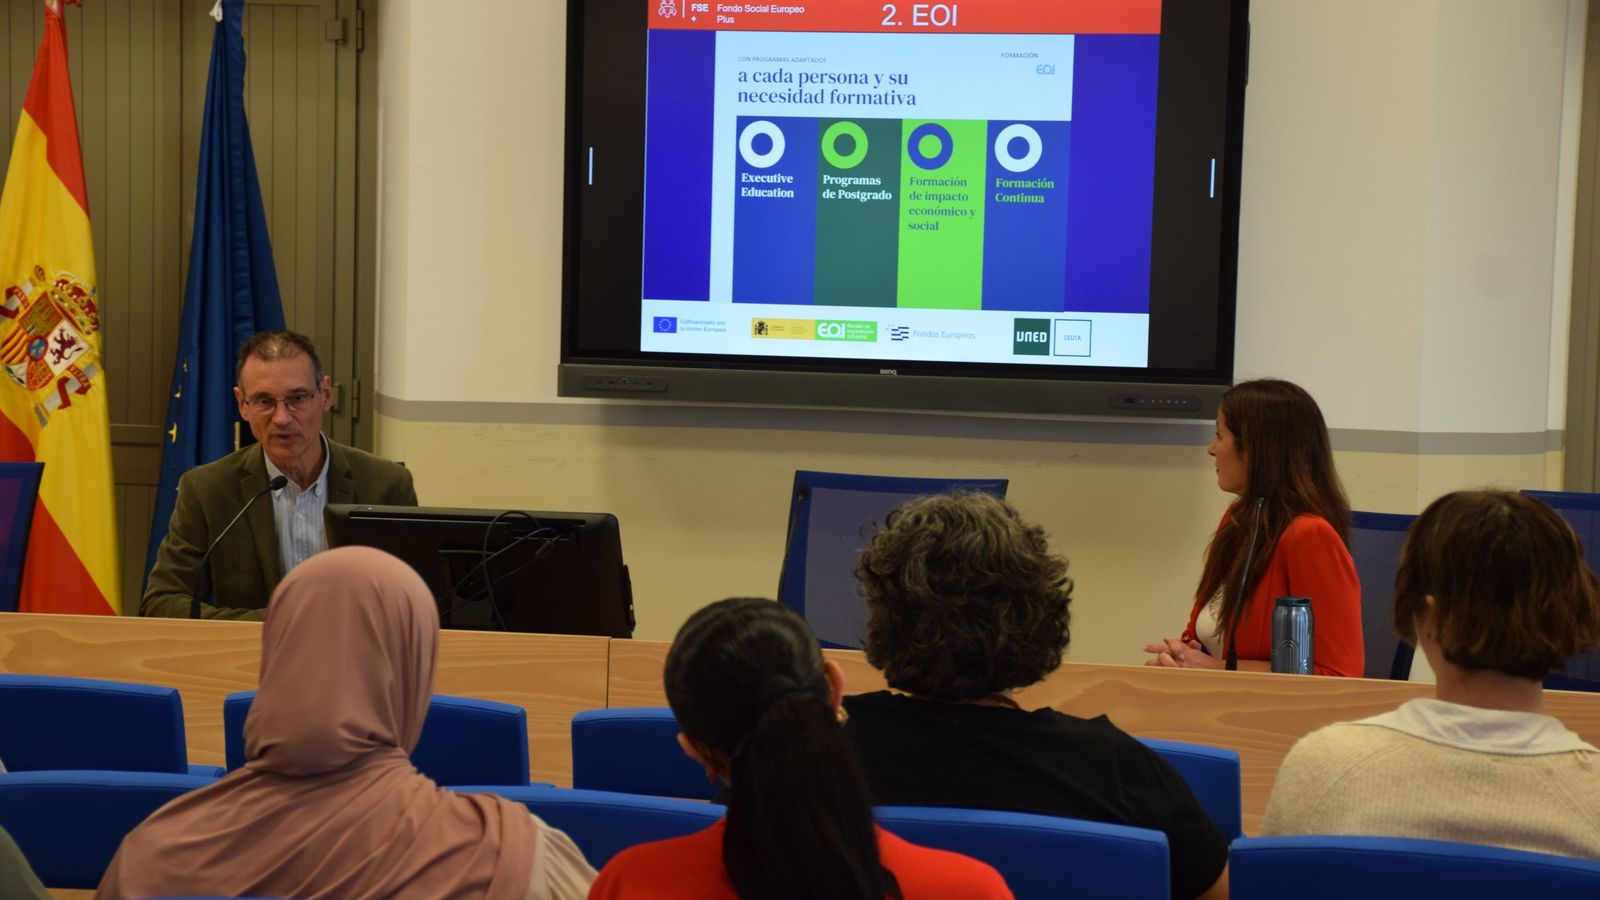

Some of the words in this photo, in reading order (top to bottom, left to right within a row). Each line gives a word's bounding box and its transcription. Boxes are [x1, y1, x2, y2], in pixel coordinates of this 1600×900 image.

[691, 3, 709, 12] FSE
[717, 3, 743, 13] Fondo
[744, 4, 769, 13] Social
[770, 4, 805, 15] Europeo
[717, 15, 735, 24] Plus
[882, 4, 903, 27] 2.
[912, 4, 958, 27] EOI
[738, 71, 748, 83] a
[752, 68, 794, 84] cada
[798, 72, 869, 88] persona
[873, 74, 884, 89] y
[888, 73, 909, 85] su
[737, 88, 825, 105] necesidad
[829, 89, 917, 106] formativa
[741, 172, 794, 185] Executive
[822, 174, 882, 189] Programas
[909, 176, 968, 188] Formación
[995, 177, 1055, 190] Formación
[741, 187, 794, 199] Education
[822, 189, 836, 200] de
[838, 190, 893, 204] Postgrado
[909, 190, 921, 202] de
[924, 191, 969, 205] impacto
[995, 192, 1045, 204] Continua
[908, 205, 967, 217] económico
[969, 208, 976, 219] y
[908, 220, 939, 231] social
[913, 330, 940, 340] Fondos
[941, 331, 976, 342] Europeos
[1016, 331, 1048, 343] UNED
